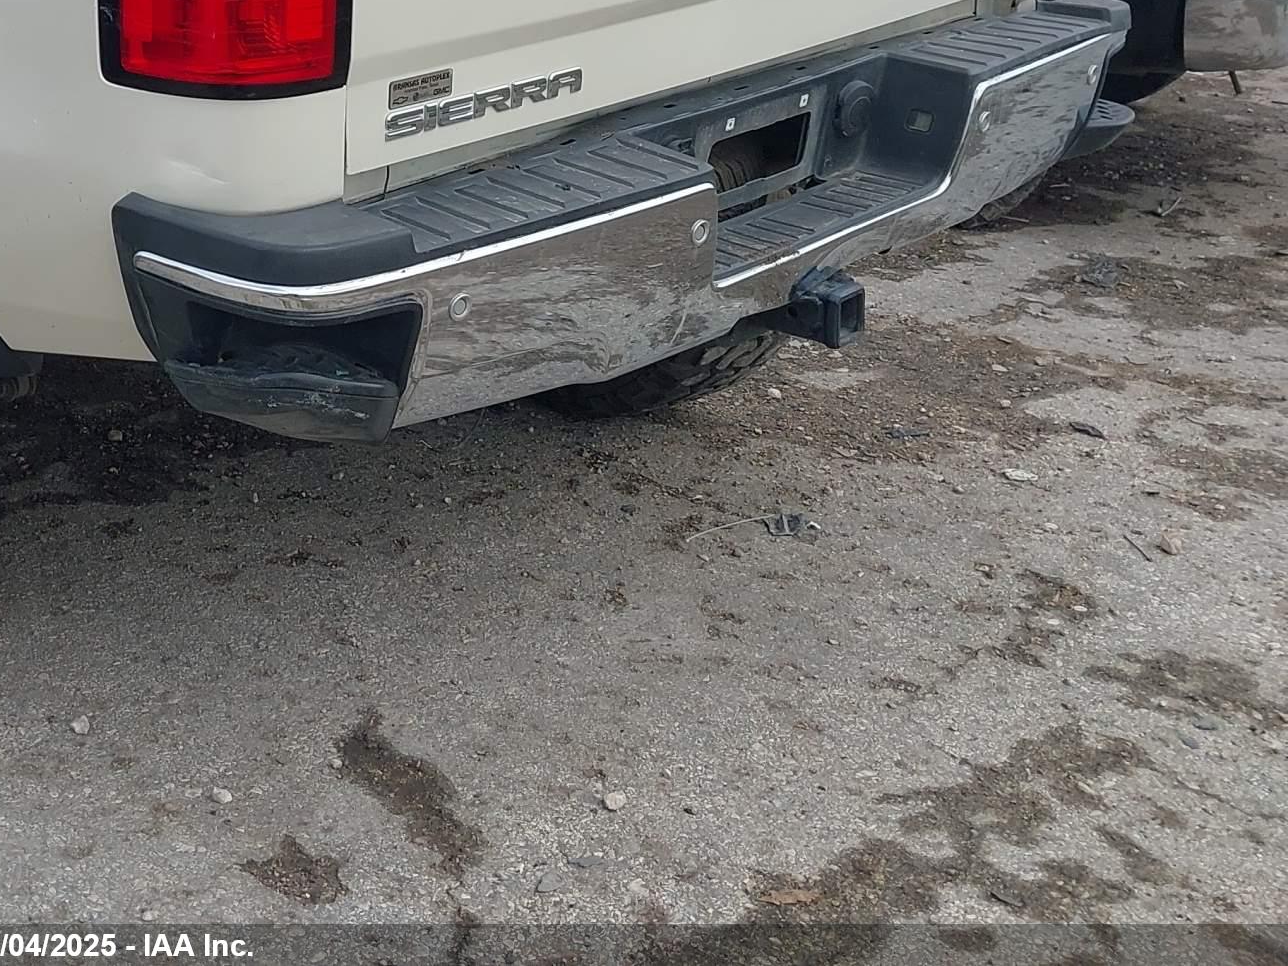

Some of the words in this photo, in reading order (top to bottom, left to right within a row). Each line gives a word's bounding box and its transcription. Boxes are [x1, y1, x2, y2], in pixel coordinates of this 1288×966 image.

[420, 71, 450, 85] AUTOPLEX
[432, 85, 450, 96] GMC
[385, 66, 583, 142] SIERRA
